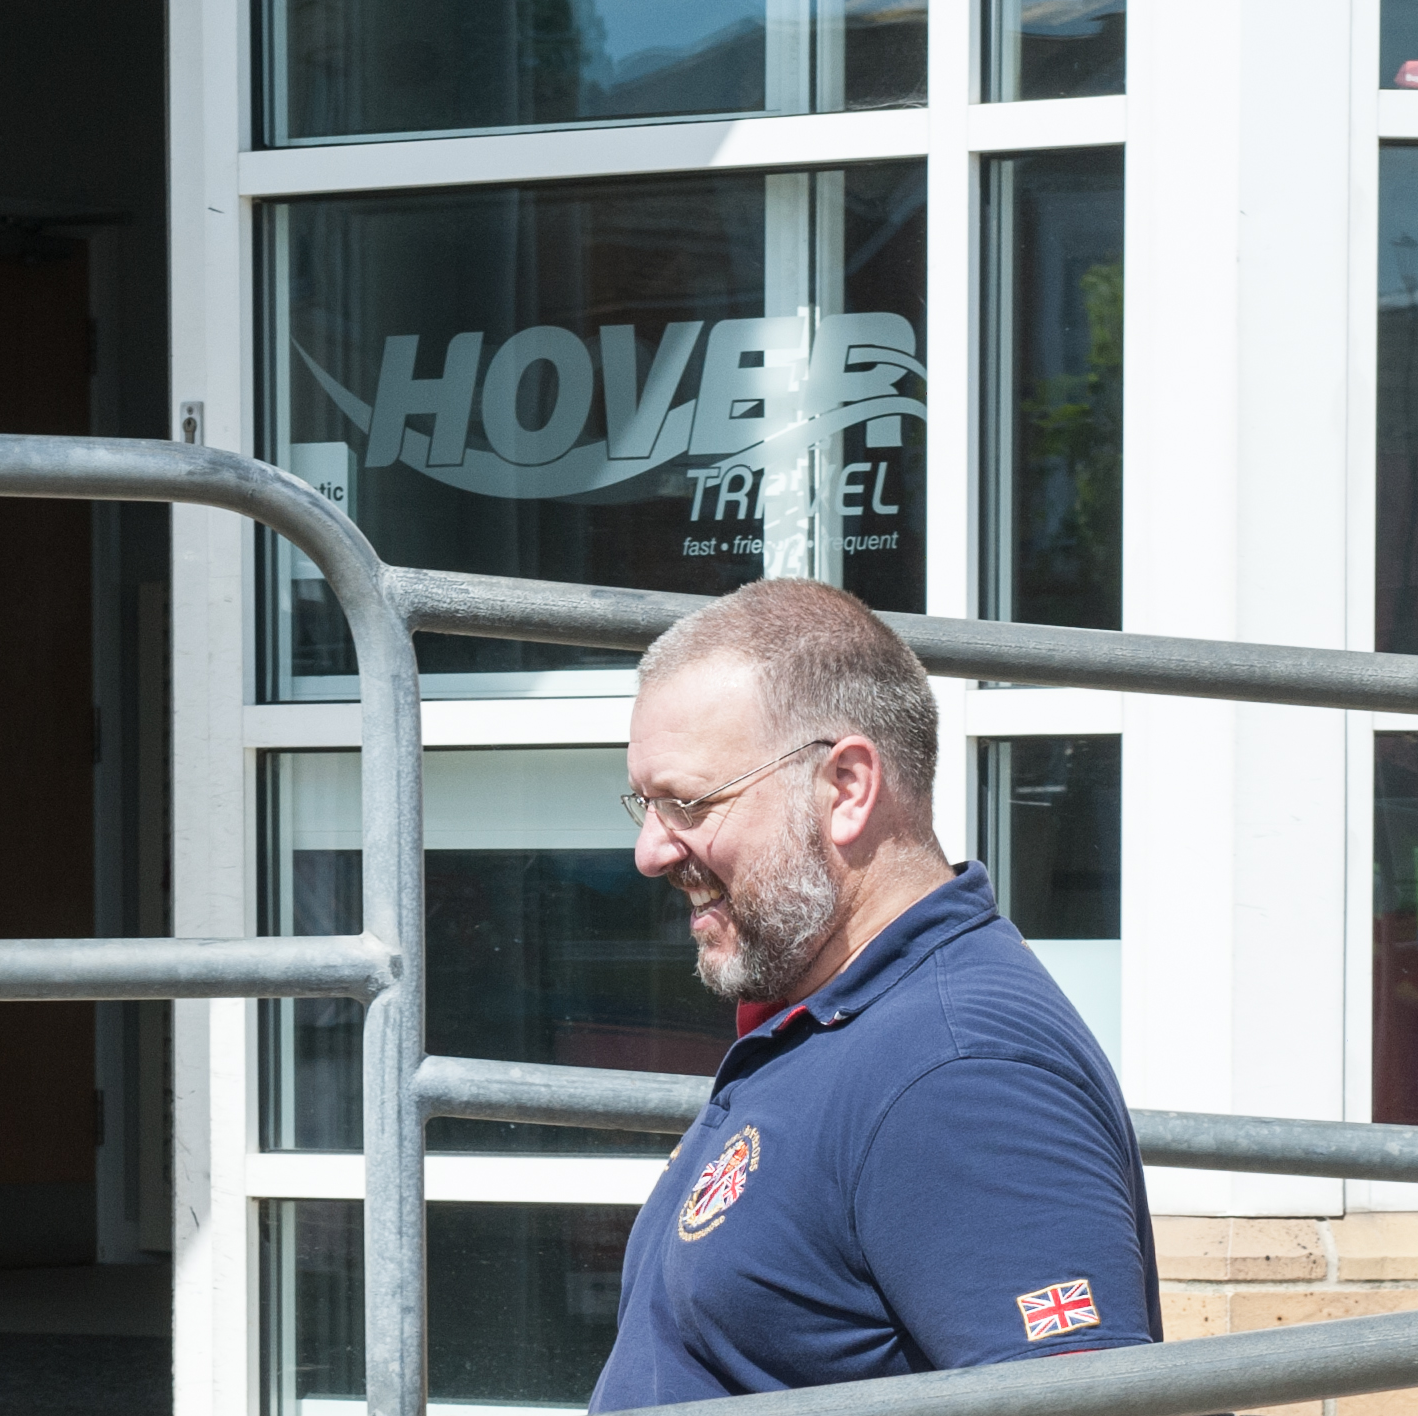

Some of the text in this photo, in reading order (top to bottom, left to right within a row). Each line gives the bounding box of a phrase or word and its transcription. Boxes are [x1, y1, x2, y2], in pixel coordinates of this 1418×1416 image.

[365, 312, 916, 468] HOVER
[683, 537, 716, 556] fast
[827, 531, 899, 555] requent
